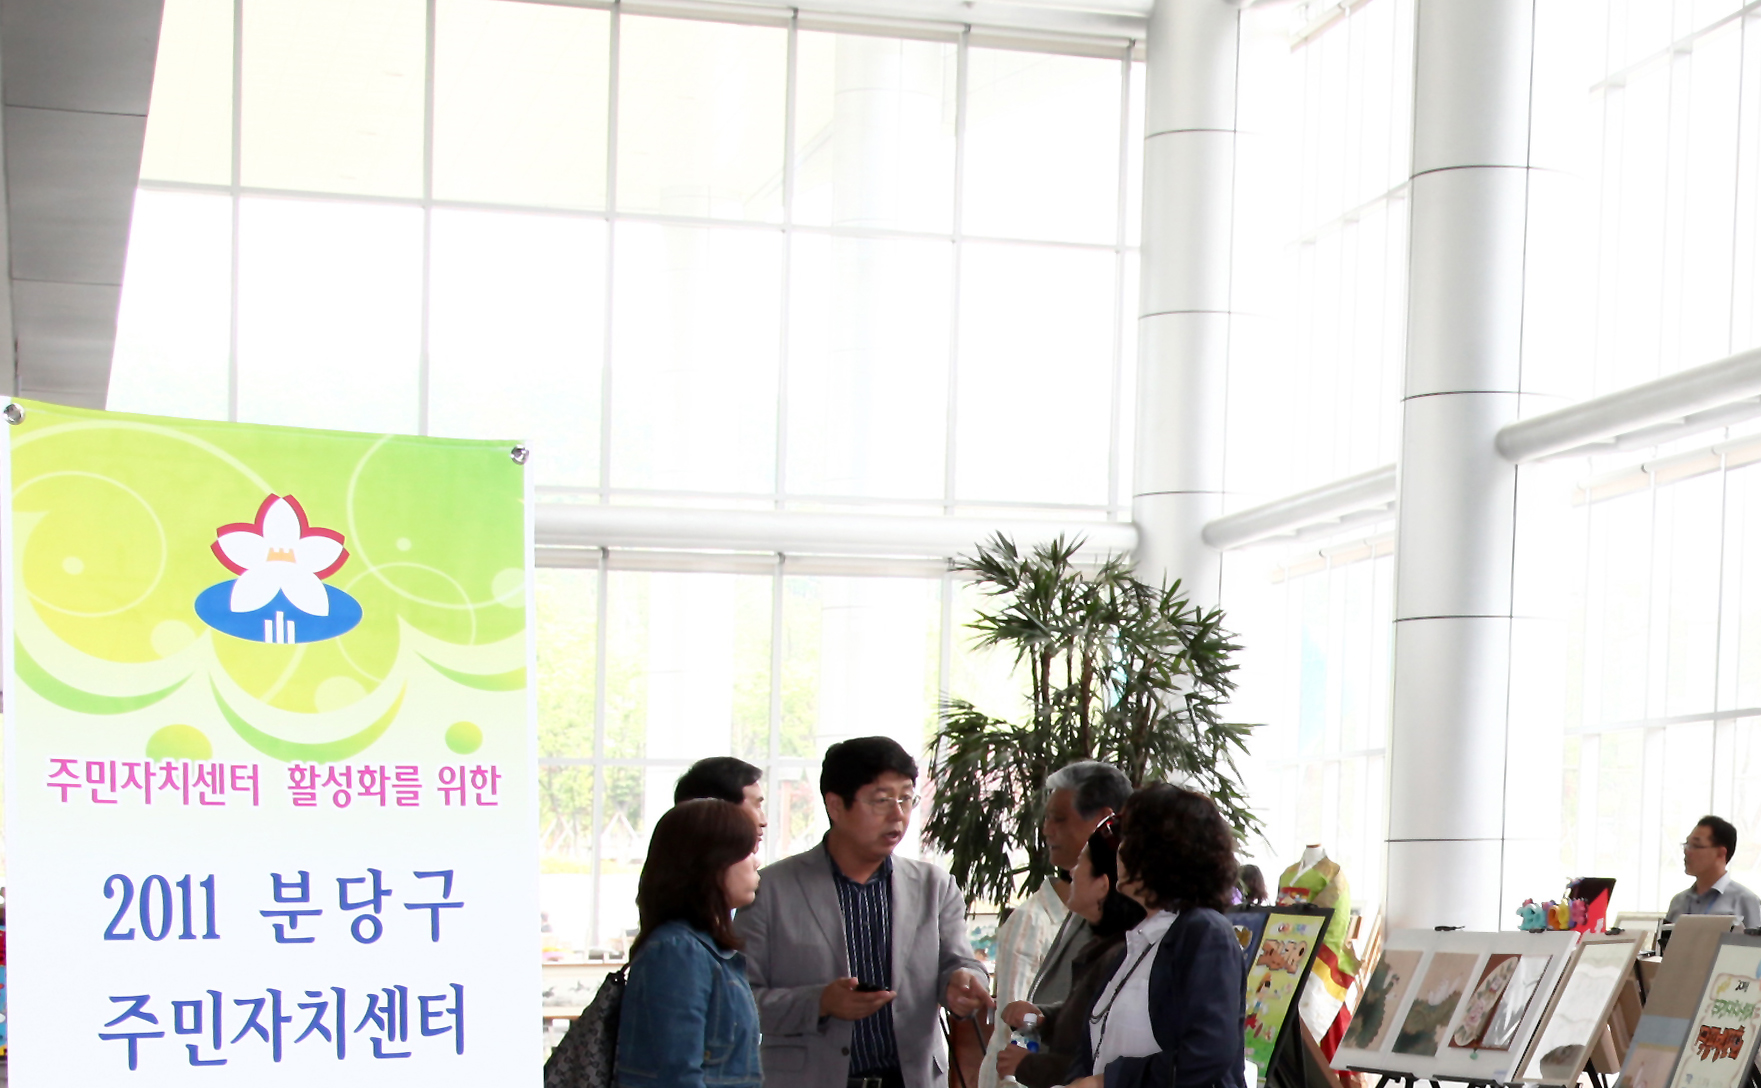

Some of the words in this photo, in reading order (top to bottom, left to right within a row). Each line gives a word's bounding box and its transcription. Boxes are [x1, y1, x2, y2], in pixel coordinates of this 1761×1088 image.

[47, 756, 261, 806] 주민자치센터
[286, 762, 422, 808] 활성화를
[437, 763, 502, 807] 위한
[104, 874, 221, 942] 2011
[260, 868, 465, 945] 분당구
[98, 983, 465, 1071] 주민자치센터
